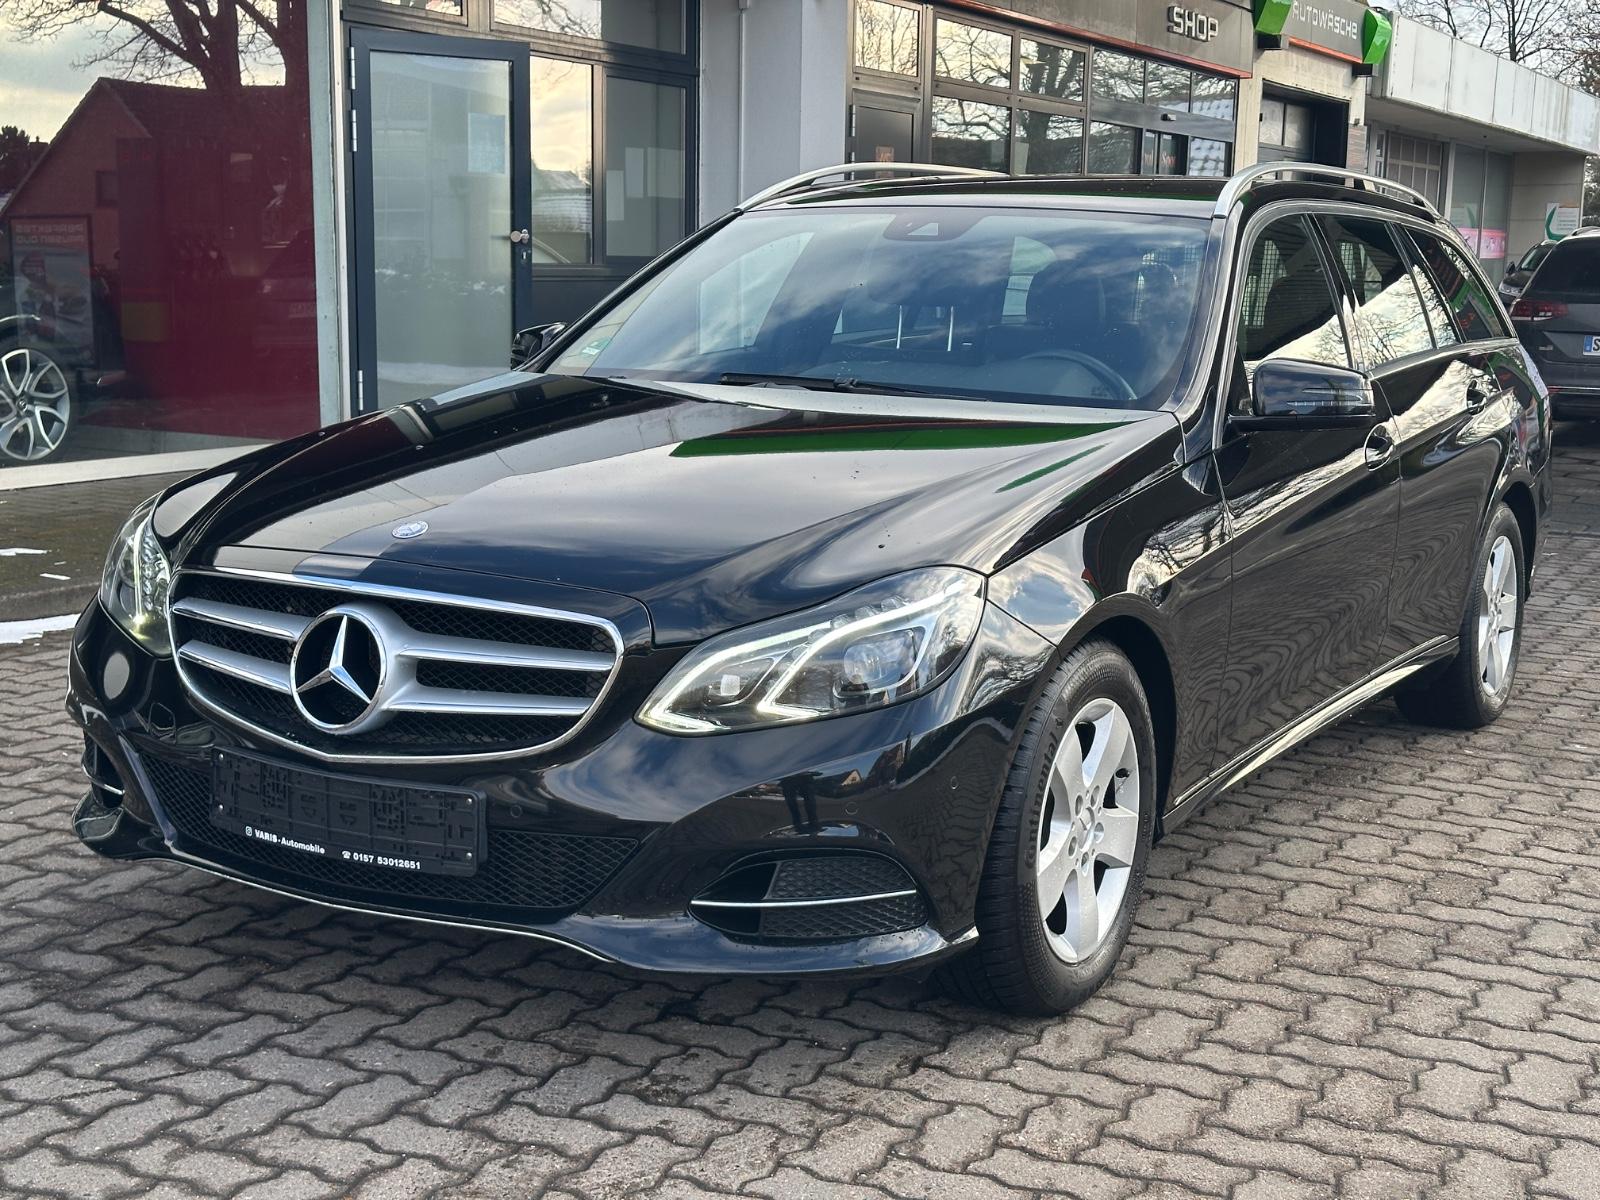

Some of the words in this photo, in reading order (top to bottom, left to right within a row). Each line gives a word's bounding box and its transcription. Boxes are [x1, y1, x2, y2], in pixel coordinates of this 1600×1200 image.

[1168, 6, 1219, 42] SHOP
[352, 852, 375, 863] 0157
[376, 855, 421, 870] 53012651
